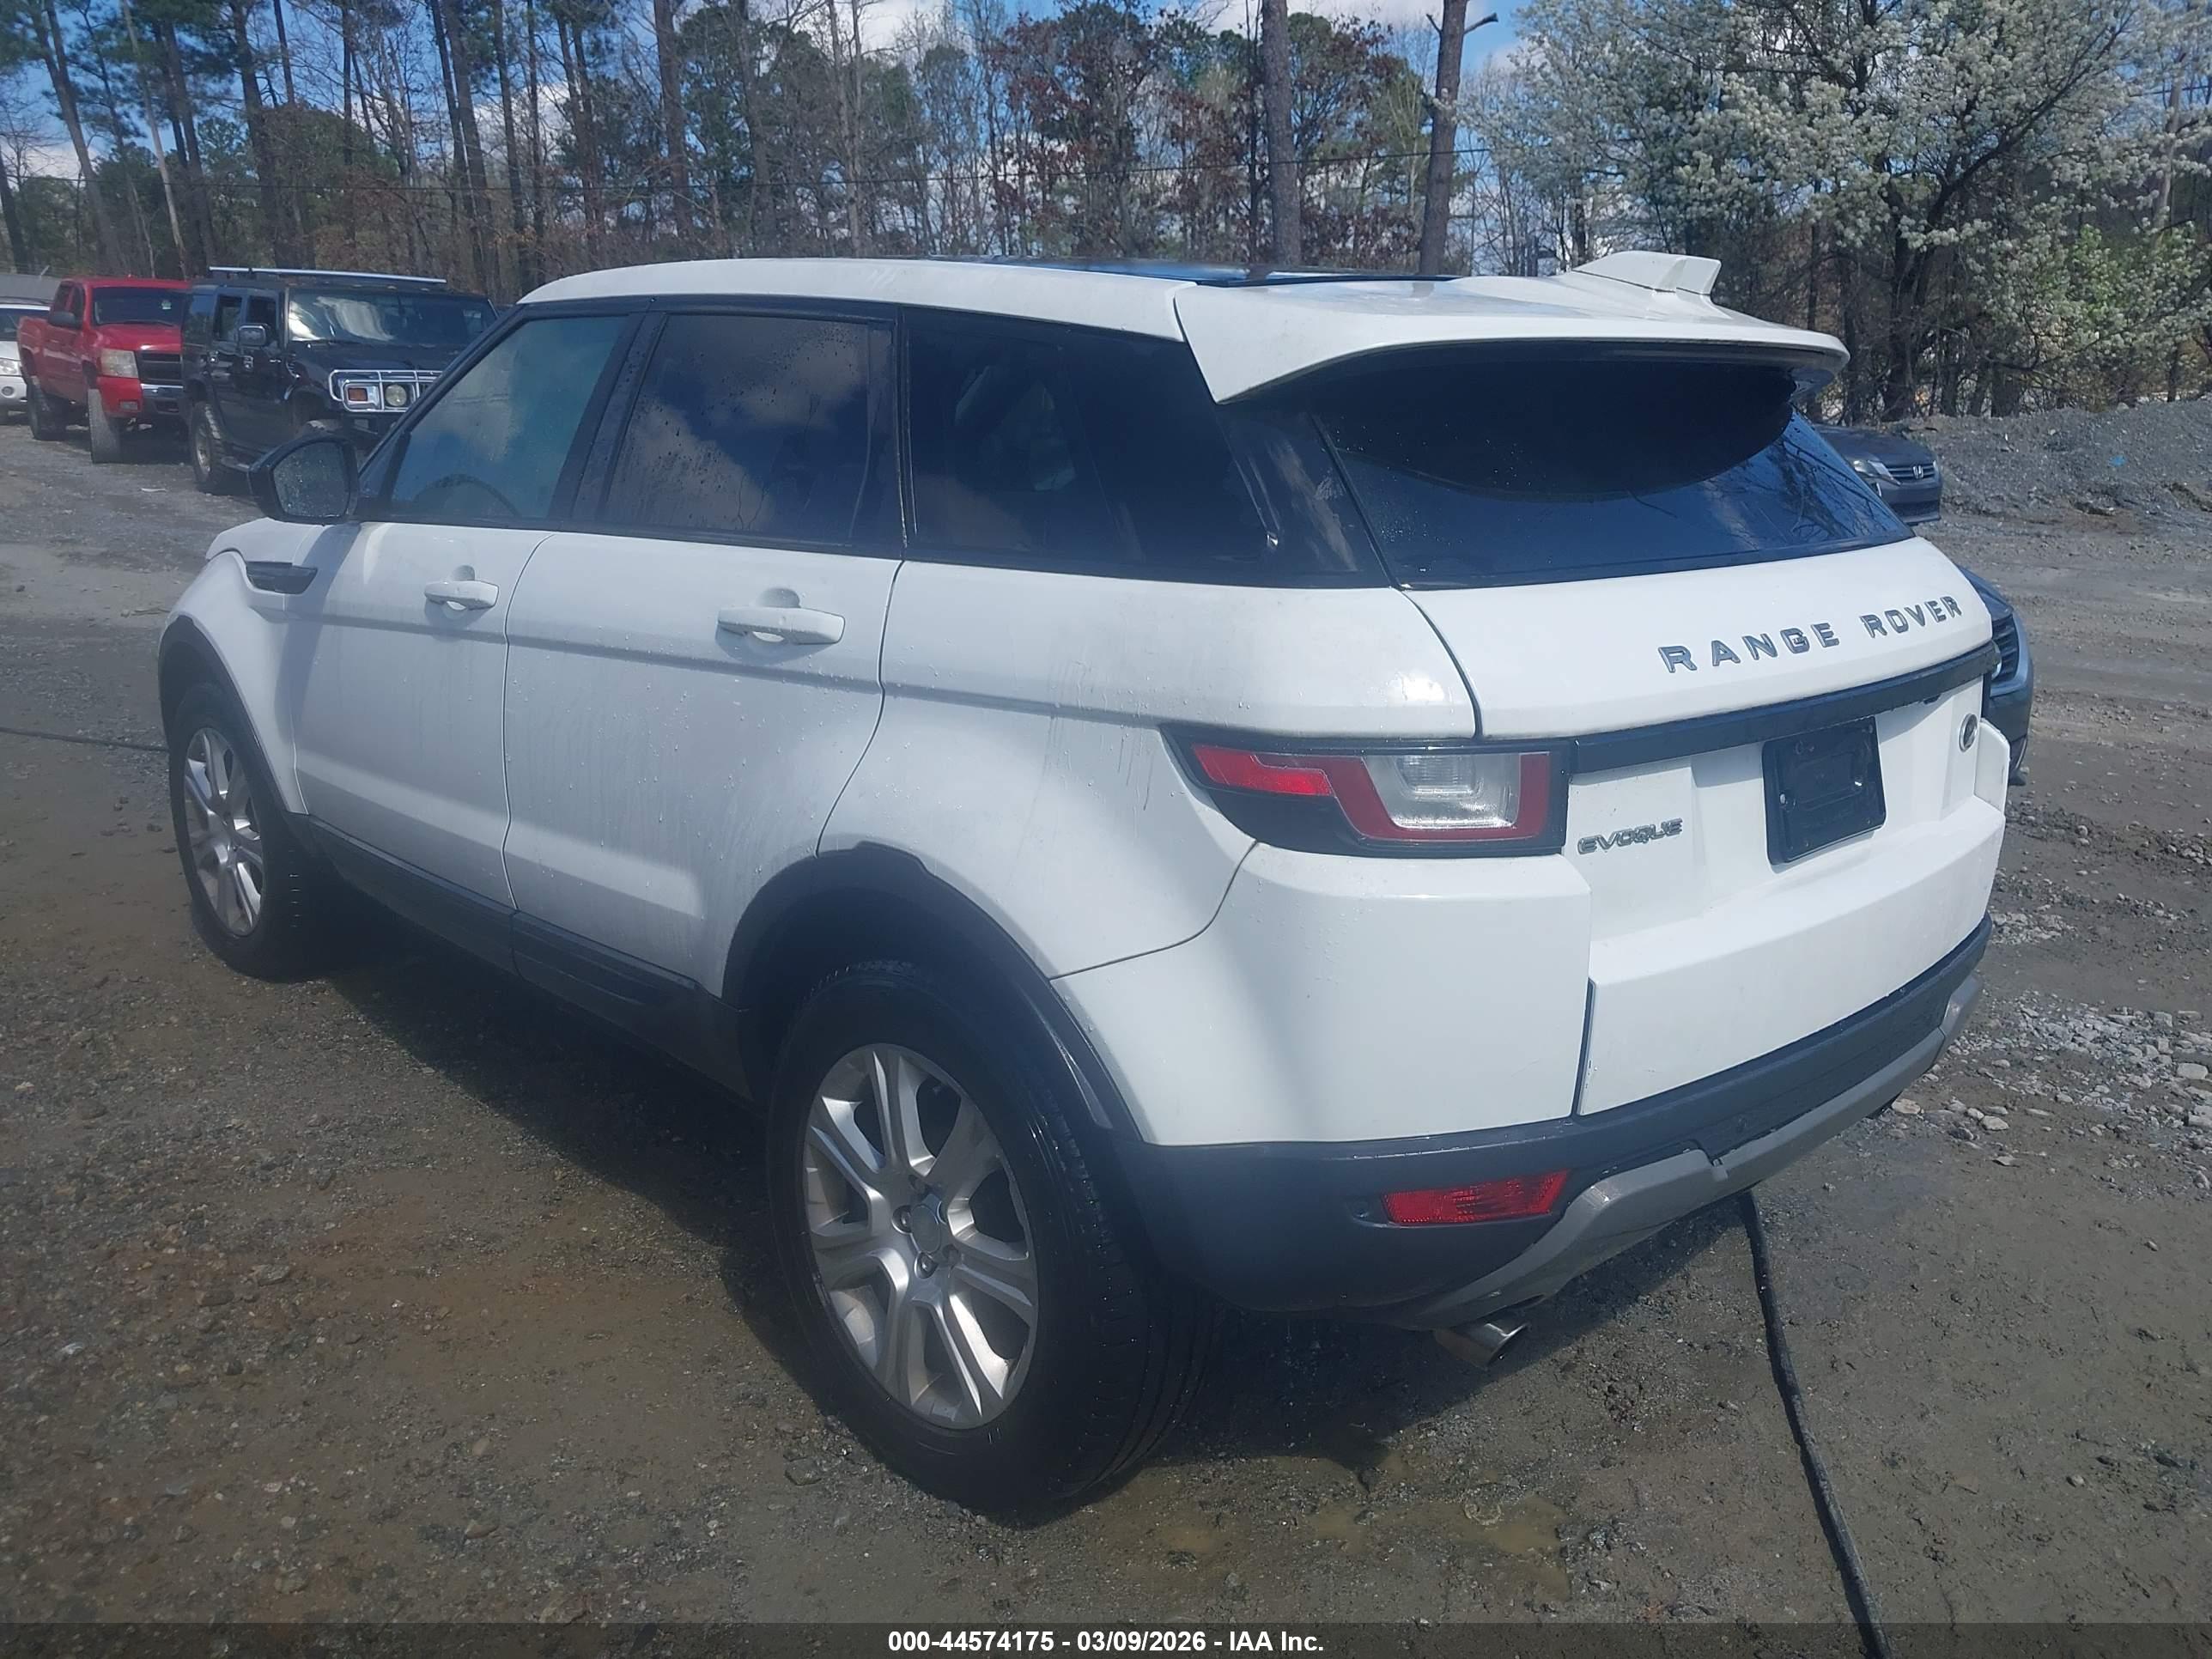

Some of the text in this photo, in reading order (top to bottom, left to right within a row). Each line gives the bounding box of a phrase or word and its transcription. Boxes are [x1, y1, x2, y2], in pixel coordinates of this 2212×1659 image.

[1658, 595, 1962, 673] RANGE ROVER
[1577, 817, 1684, 854] EVOQUE
